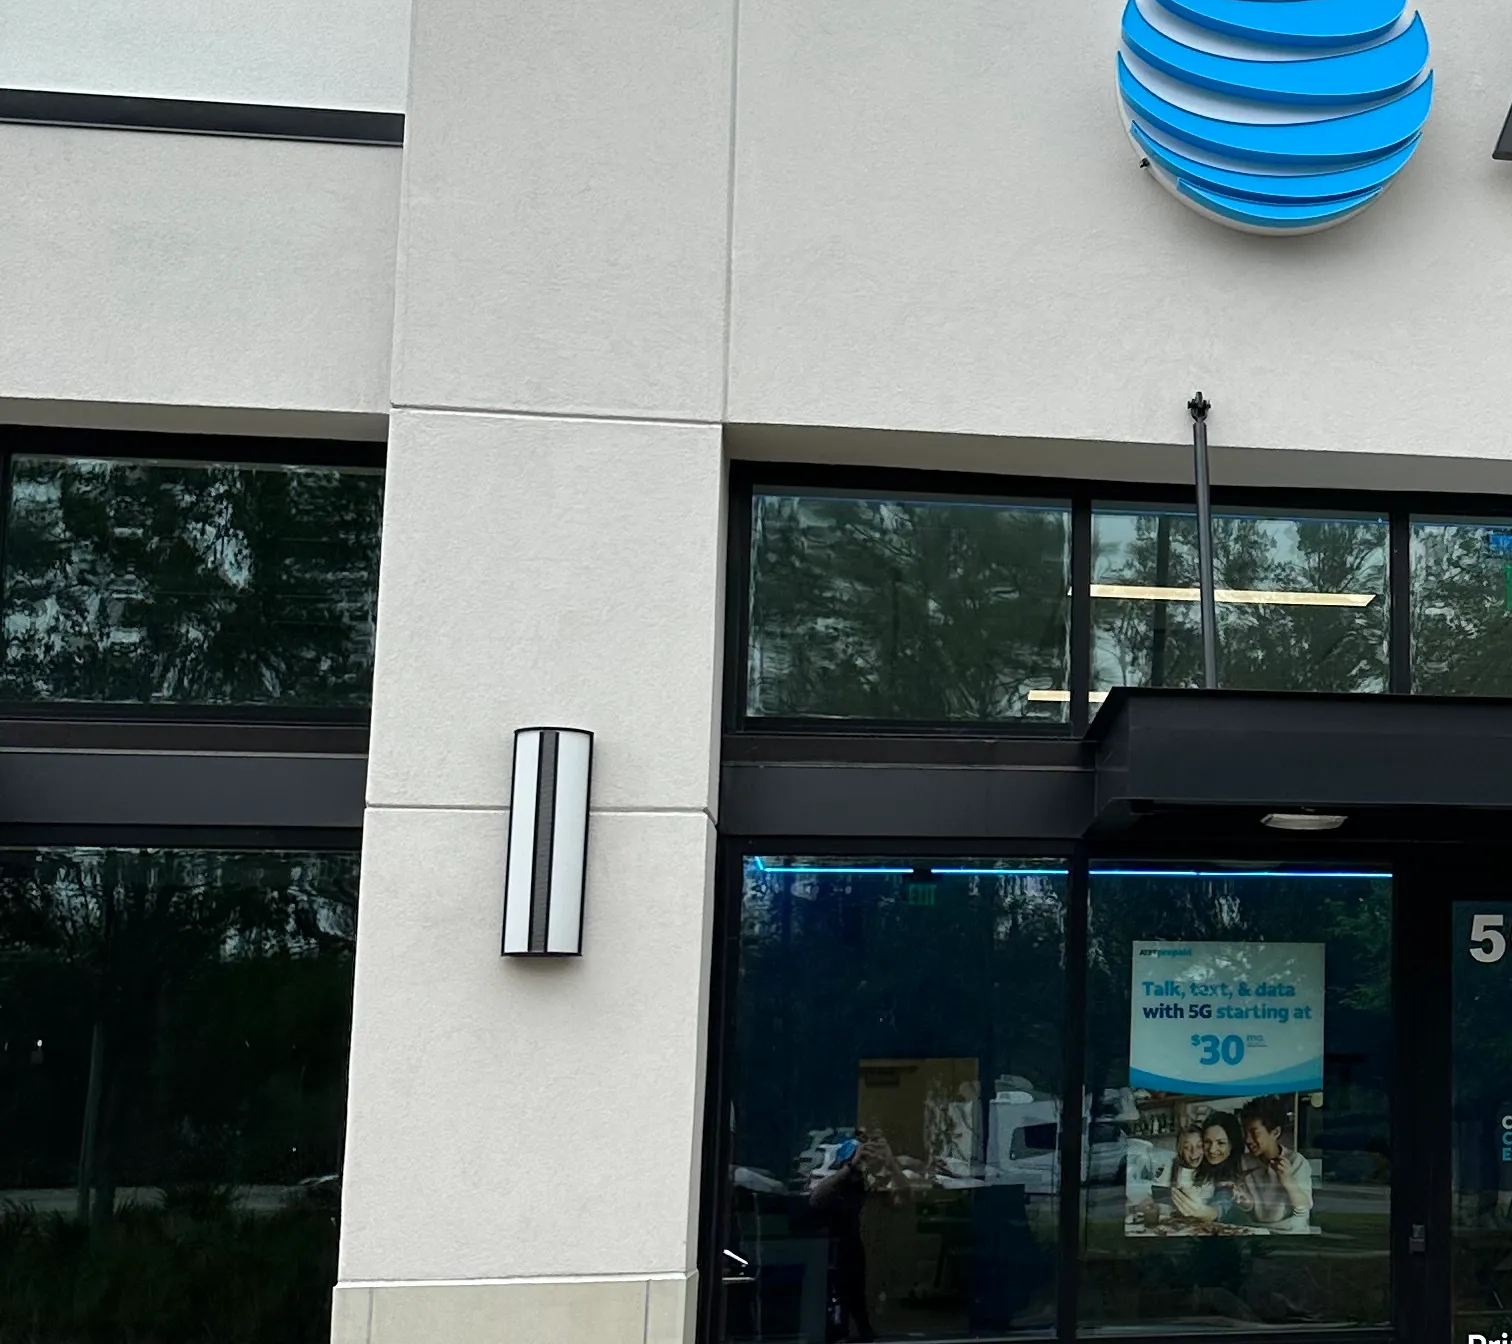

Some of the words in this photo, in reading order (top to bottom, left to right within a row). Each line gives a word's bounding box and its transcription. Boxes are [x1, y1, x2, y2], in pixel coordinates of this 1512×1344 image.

[1142, 981, 1186, 1000] Talk,
[1190, 982, 1234, 1000] text,
[1237, 981, 1251, 997] &
[1255, 981, 1296, 997] data
[1142, 1003, 1185, 1019] with
[1188, 1004, 1213, 1019] 5G
[1216, 1004, 1290, 1023] starting
[1293, 1005, 1313, 1019] at
[1190, 1033, 1245, 1066] $30
